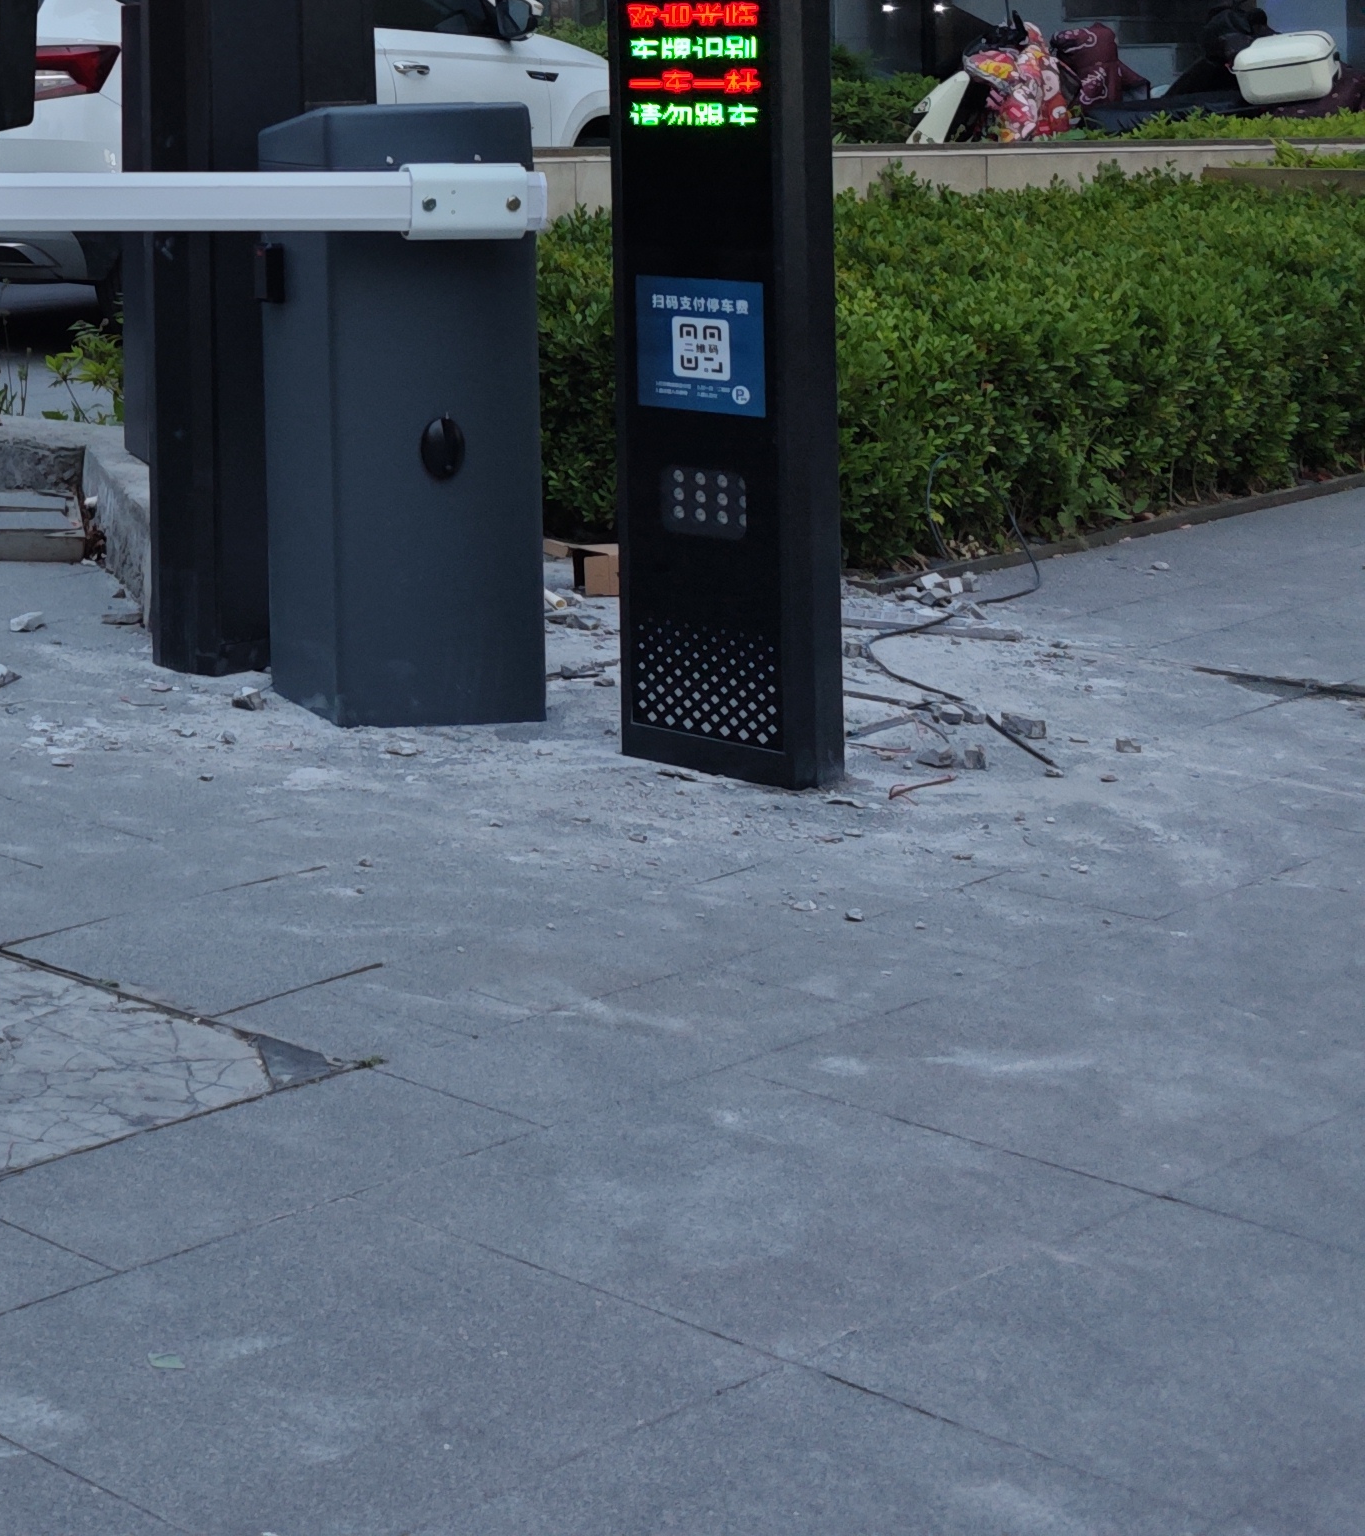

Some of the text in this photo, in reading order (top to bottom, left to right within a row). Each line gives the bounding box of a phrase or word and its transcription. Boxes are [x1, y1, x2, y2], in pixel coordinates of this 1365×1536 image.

[630, 35, 758, 60] 车牌识别
[629, 69, 761, 94] 一车一杆
[629, 101, 759, 126] 请勿跟车
[651, 293, 749, 315] 扫码支付停车费
[684, 343, 719, 355] 二维码
